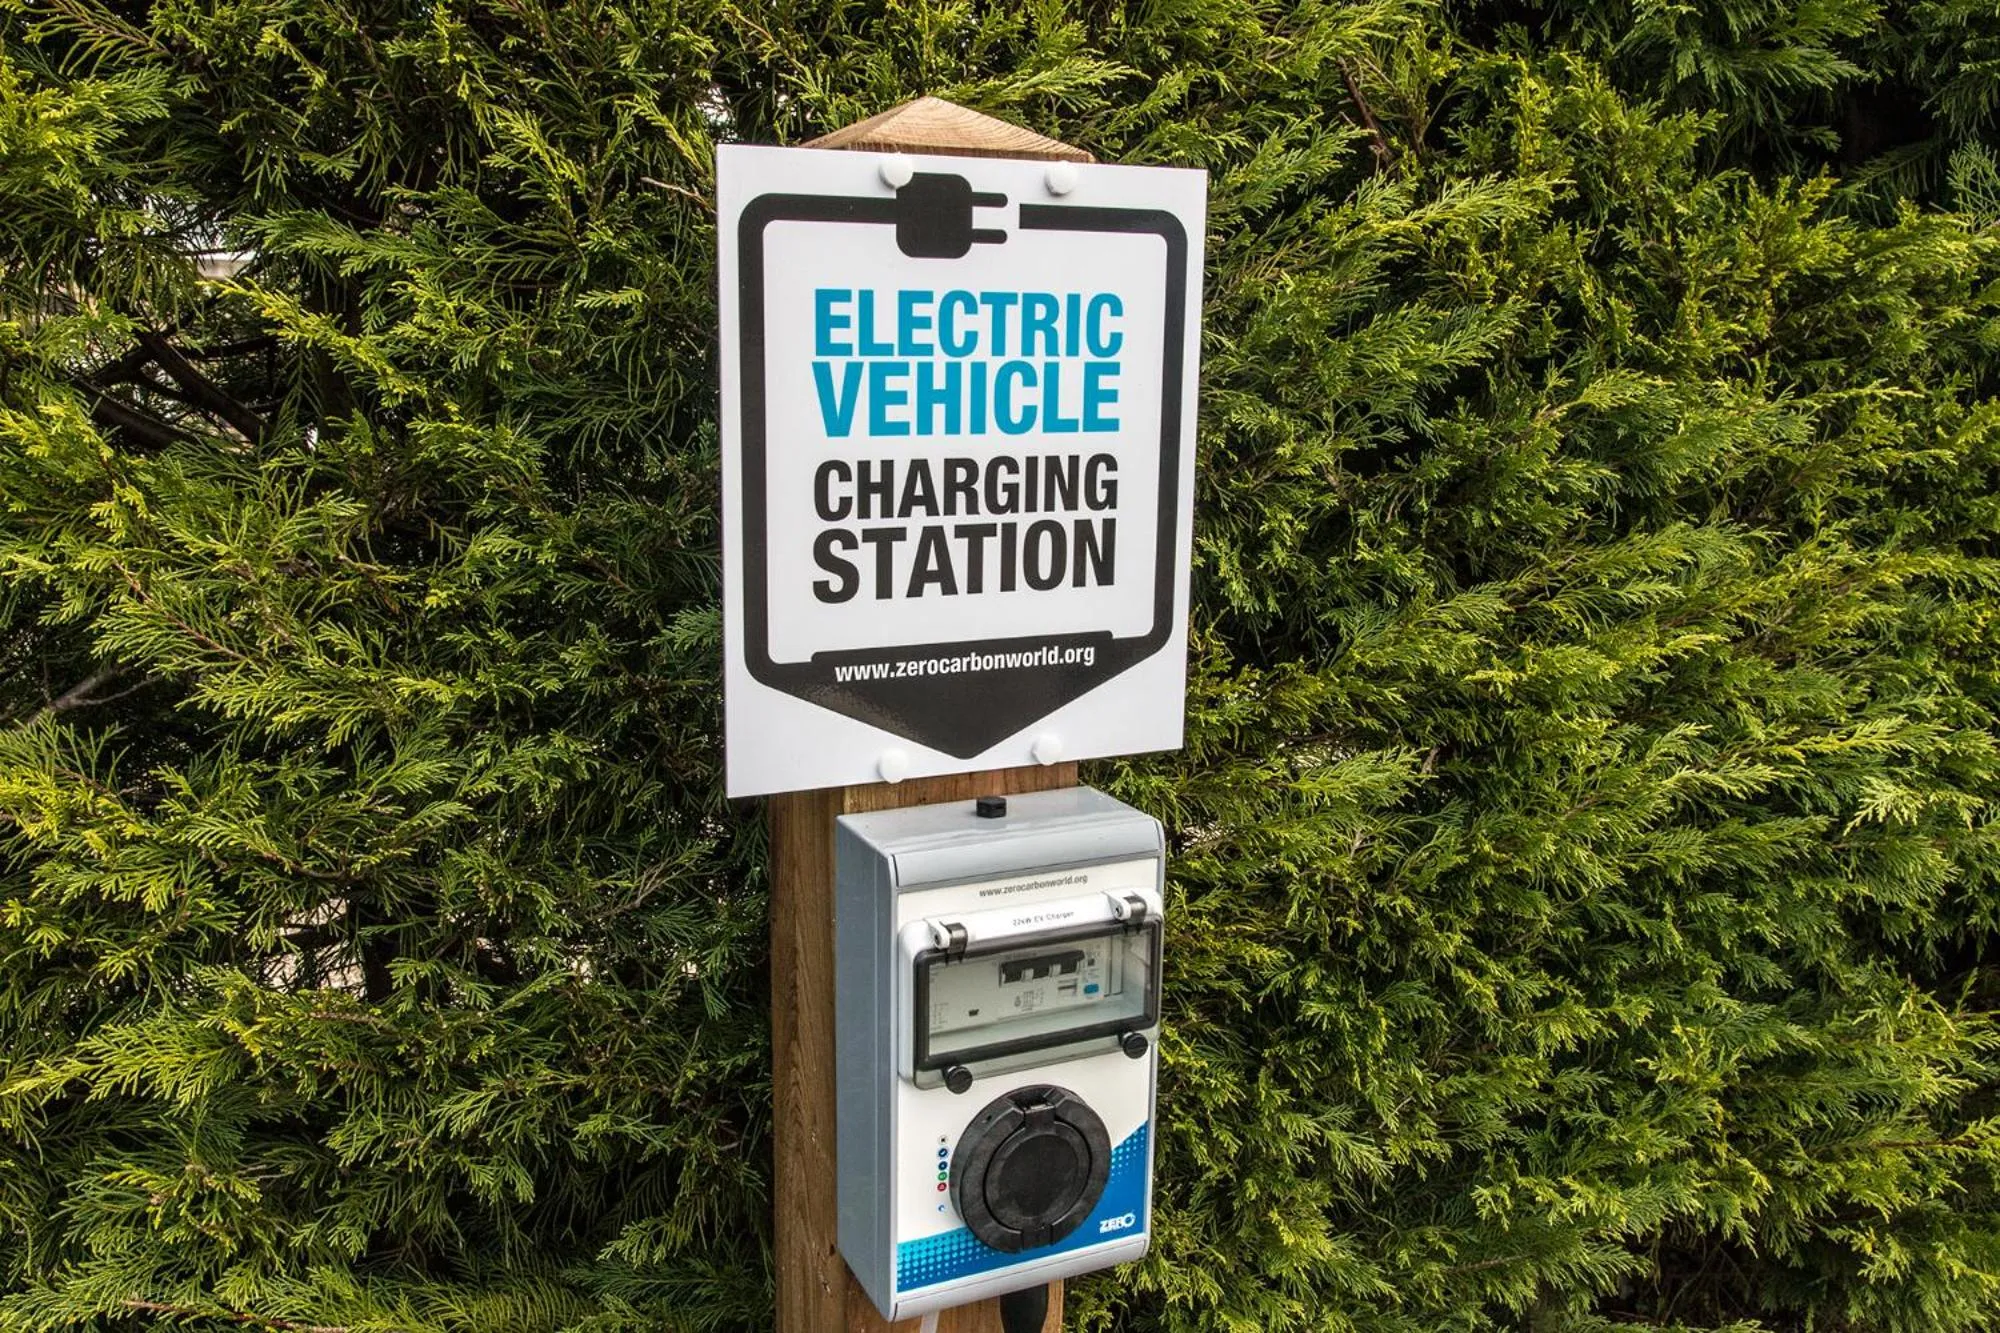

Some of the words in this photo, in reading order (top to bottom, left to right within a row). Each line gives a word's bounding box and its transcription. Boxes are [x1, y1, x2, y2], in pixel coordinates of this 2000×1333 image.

[815, 288, 1124, 358] ELECTRIC
[812, 360, 1121, 438] VEHICLE
[813, 453, 1119, 522] CHARGING
[812, 518, 1116, 604] STATION
[834, 644, 1096, 683] www.zerocarbonworld.org
[979, 874, 1089, 897] www.zerocarbonworld.org
[1099, 1211, 1136, 1234] ZERO
